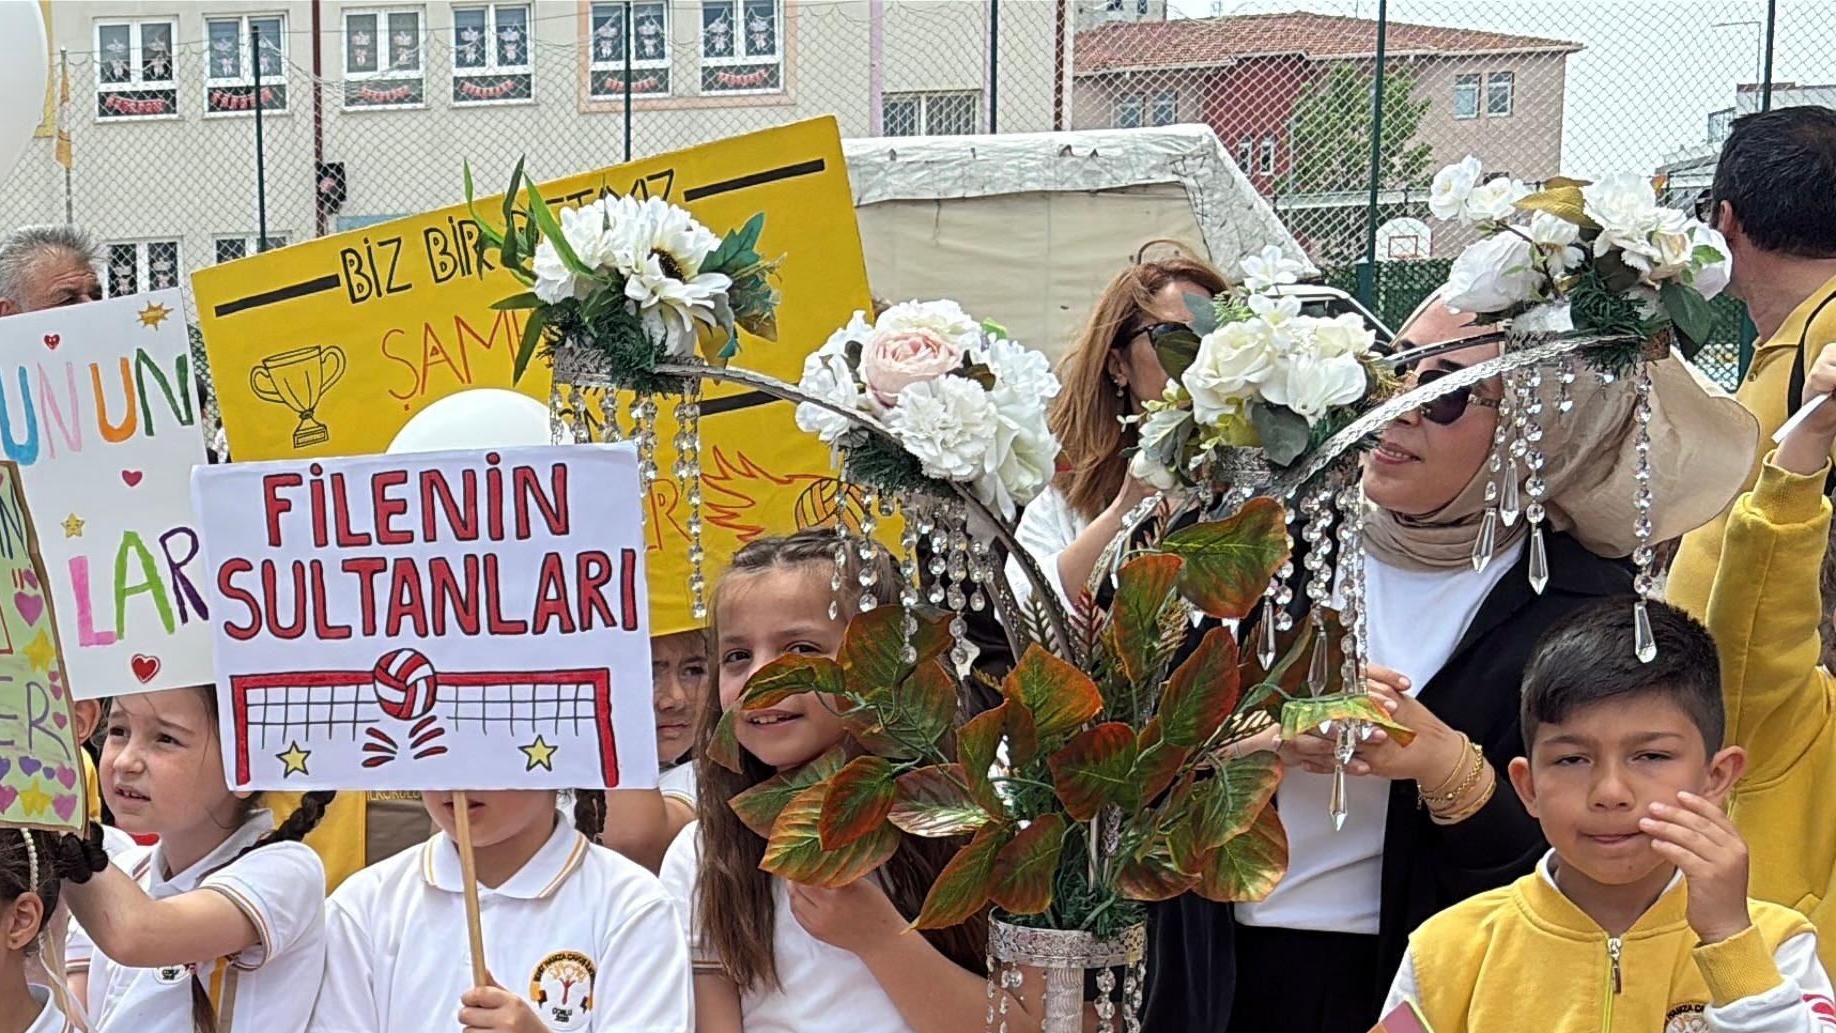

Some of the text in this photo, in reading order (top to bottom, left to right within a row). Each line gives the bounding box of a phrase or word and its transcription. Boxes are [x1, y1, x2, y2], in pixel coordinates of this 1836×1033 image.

[340, 215, 496, 305] BİZ BİR
[263, 452, 570, 548] FİLENİN
[217, 547, 640, 641] SULTANLARI
